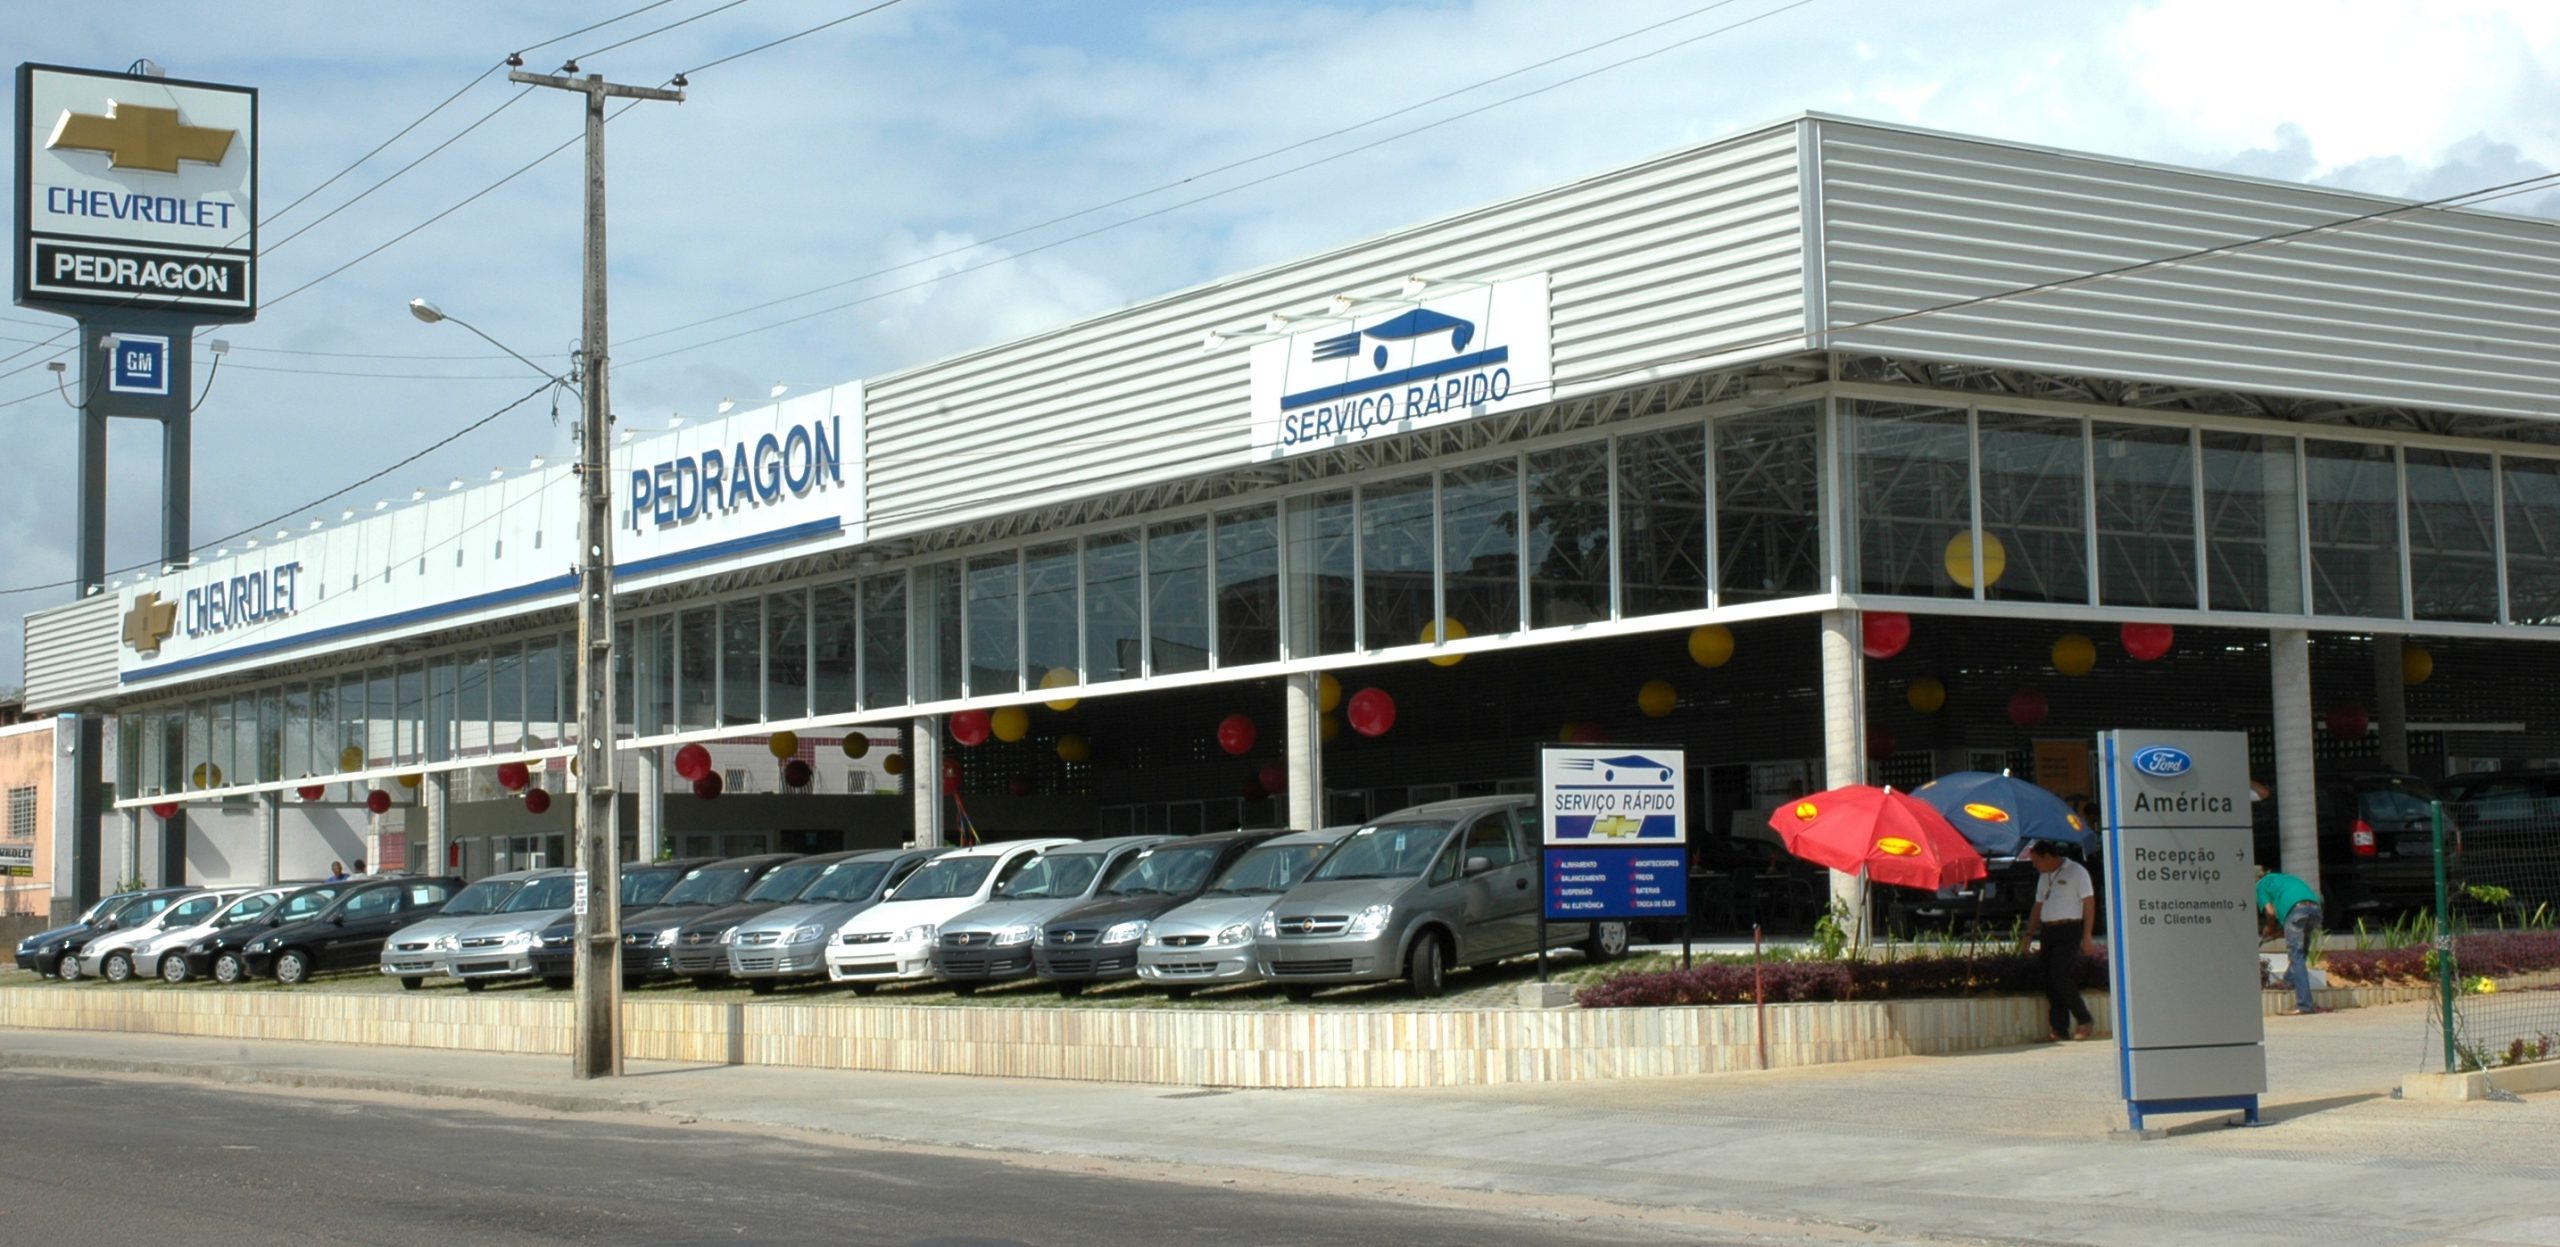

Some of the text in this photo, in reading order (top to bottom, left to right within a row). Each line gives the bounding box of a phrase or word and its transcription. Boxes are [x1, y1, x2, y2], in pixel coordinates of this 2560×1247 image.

[48, 187, 235, 229] CHEVROLET
[54, 253, 228, 292] PEDRAGON
[126, 351, 153, 372] GM
[1283, 367, 1511, 446] SERVIÇO RÁPIDO
[632, 415, 841, 530] PEDRAGON
[186, 561, 300, 636] CHEVROLET
[2149, 752, 2182, 772] Ford
[1555, 790, 1675, 814] SERVIÇO RÁPIDO
[2134, 792, 2233, 813] América
[2135, 848, 2216, 866] Recepção
[2136, 867, 2221, 884] de Serviço
[2139, 900, 2234, 910] Estacionamento
[2139, 914, 2212, 925] de Clientes
